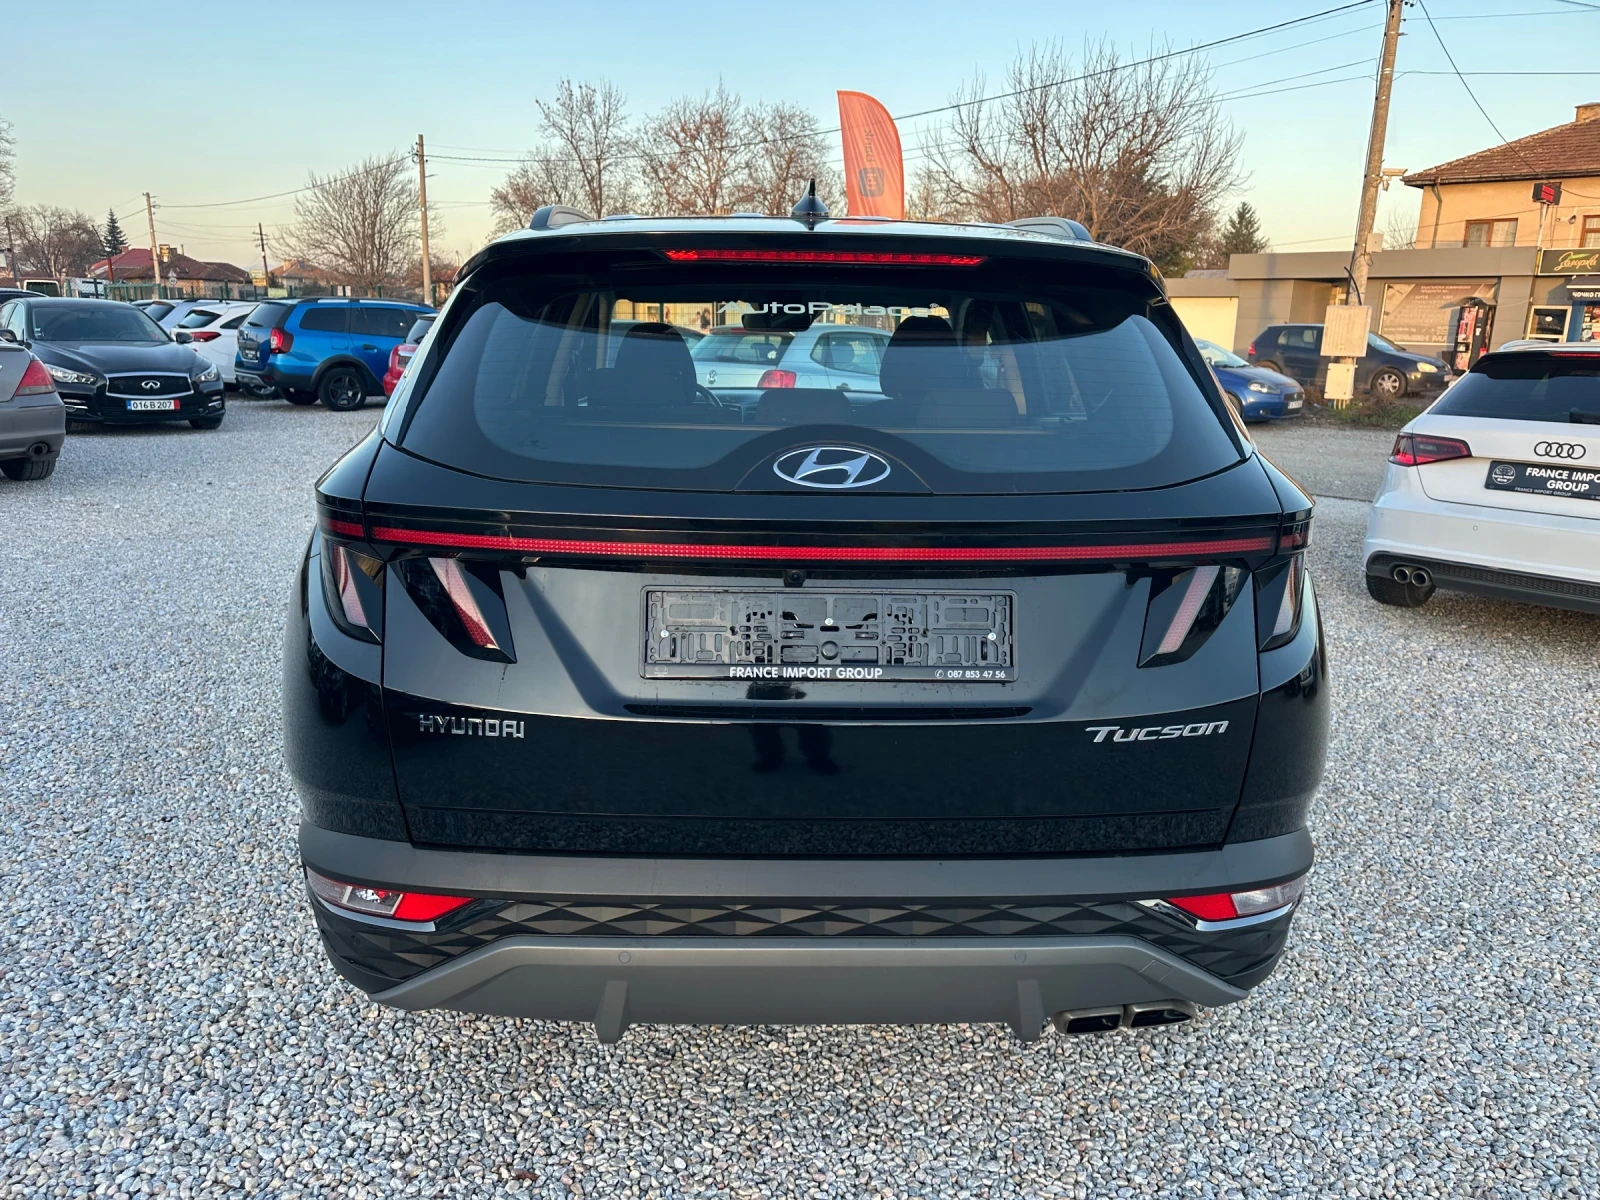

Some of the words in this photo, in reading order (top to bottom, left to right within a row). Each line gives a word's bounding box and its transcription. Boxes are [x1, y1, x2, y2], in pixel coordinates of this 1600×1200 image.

[717, 300, 932, 318] AutoPalace
[132, 401, 149, 409] 016
[156, 401, 172, 409] 207
[1525, 467, 1569, 480] FRANCE
[1546, 479, 1590, 492] GROUP
[729, 666, 778, 678] FRANCE
[783, 667, 832, 679] IMPORT
[836, 667, 883, 679] GROUP
[947, 670, 963, 678] 087
[965, 670, 980, 678] 853
[982, 670, 993, 678] 47
[995, 670, 1006, 679] 56
[420, 714, 525, 739] HYUNDAI
